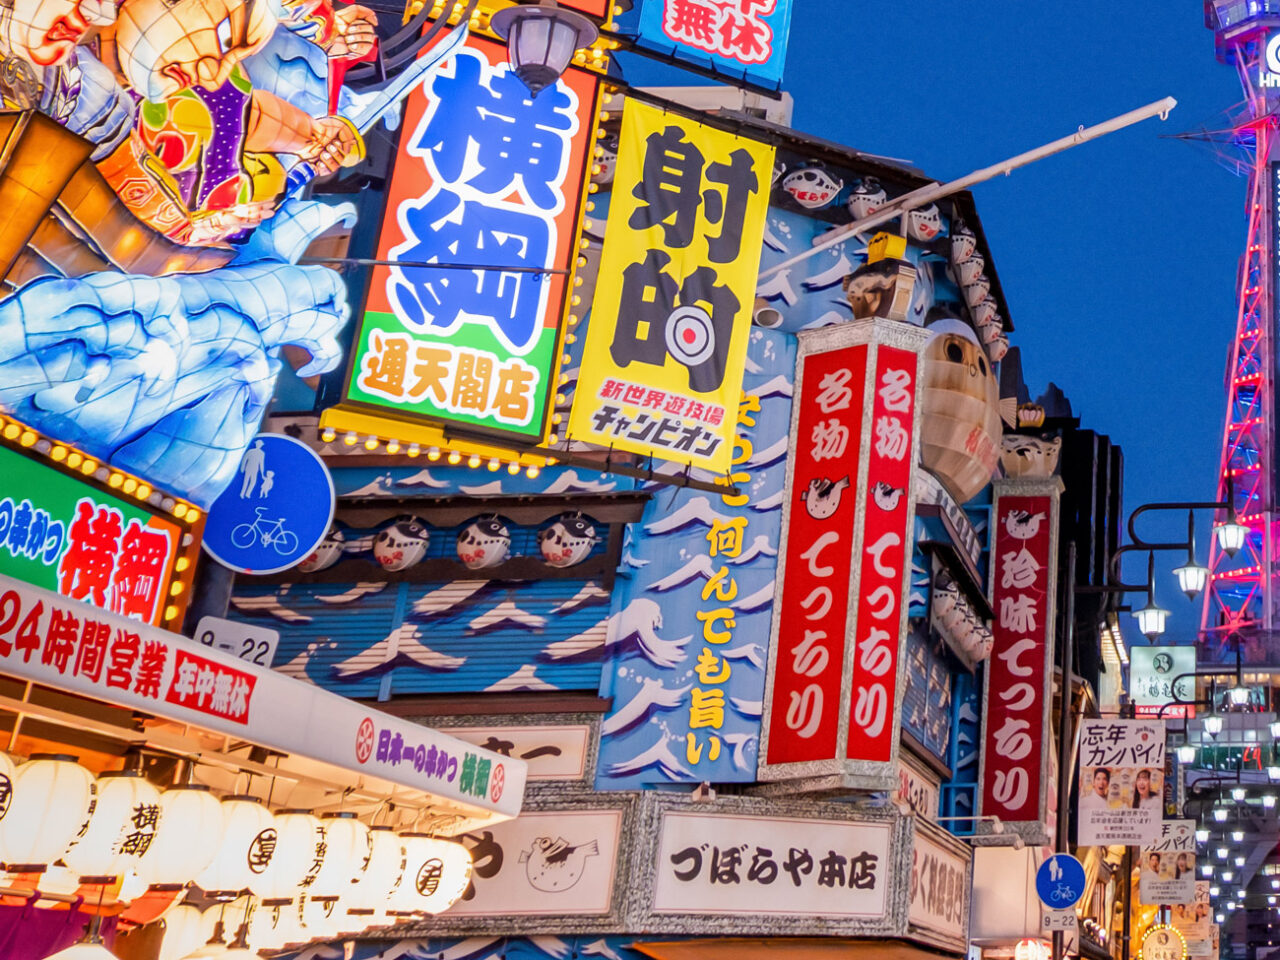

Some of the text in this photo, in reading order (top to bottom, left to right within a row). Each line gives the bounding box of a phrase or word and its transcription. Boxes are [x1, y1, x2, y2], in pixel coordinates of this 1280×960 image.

[671, 0, 767, 58] 無休
[397, 53, 573, 348] 横綱
[610, 125, 759, 393] 射的
[367, 334, 534, 421] 通天閣店
[599, 378, 726, 426] 新世界遊技場
[593, 405, 722, 457] チャンピオン
[60, 501, 169, 623] 横綱
[786, 368, 852, 739] 名物 てっちり
[854, 368, 912, 738] 名物 てっちり
[0, 590, 251, 718] 24時間営業 年中無休
[993, 548, 1041, 810] 珍味てっちり
[376, 729, 457, 783] 日本一の串かつ
[1082, 724, 1128, 746] 忘年
[670, 843, 879, 890] づぼらや本店
[1044, 914, 1075, 927] 9-22
